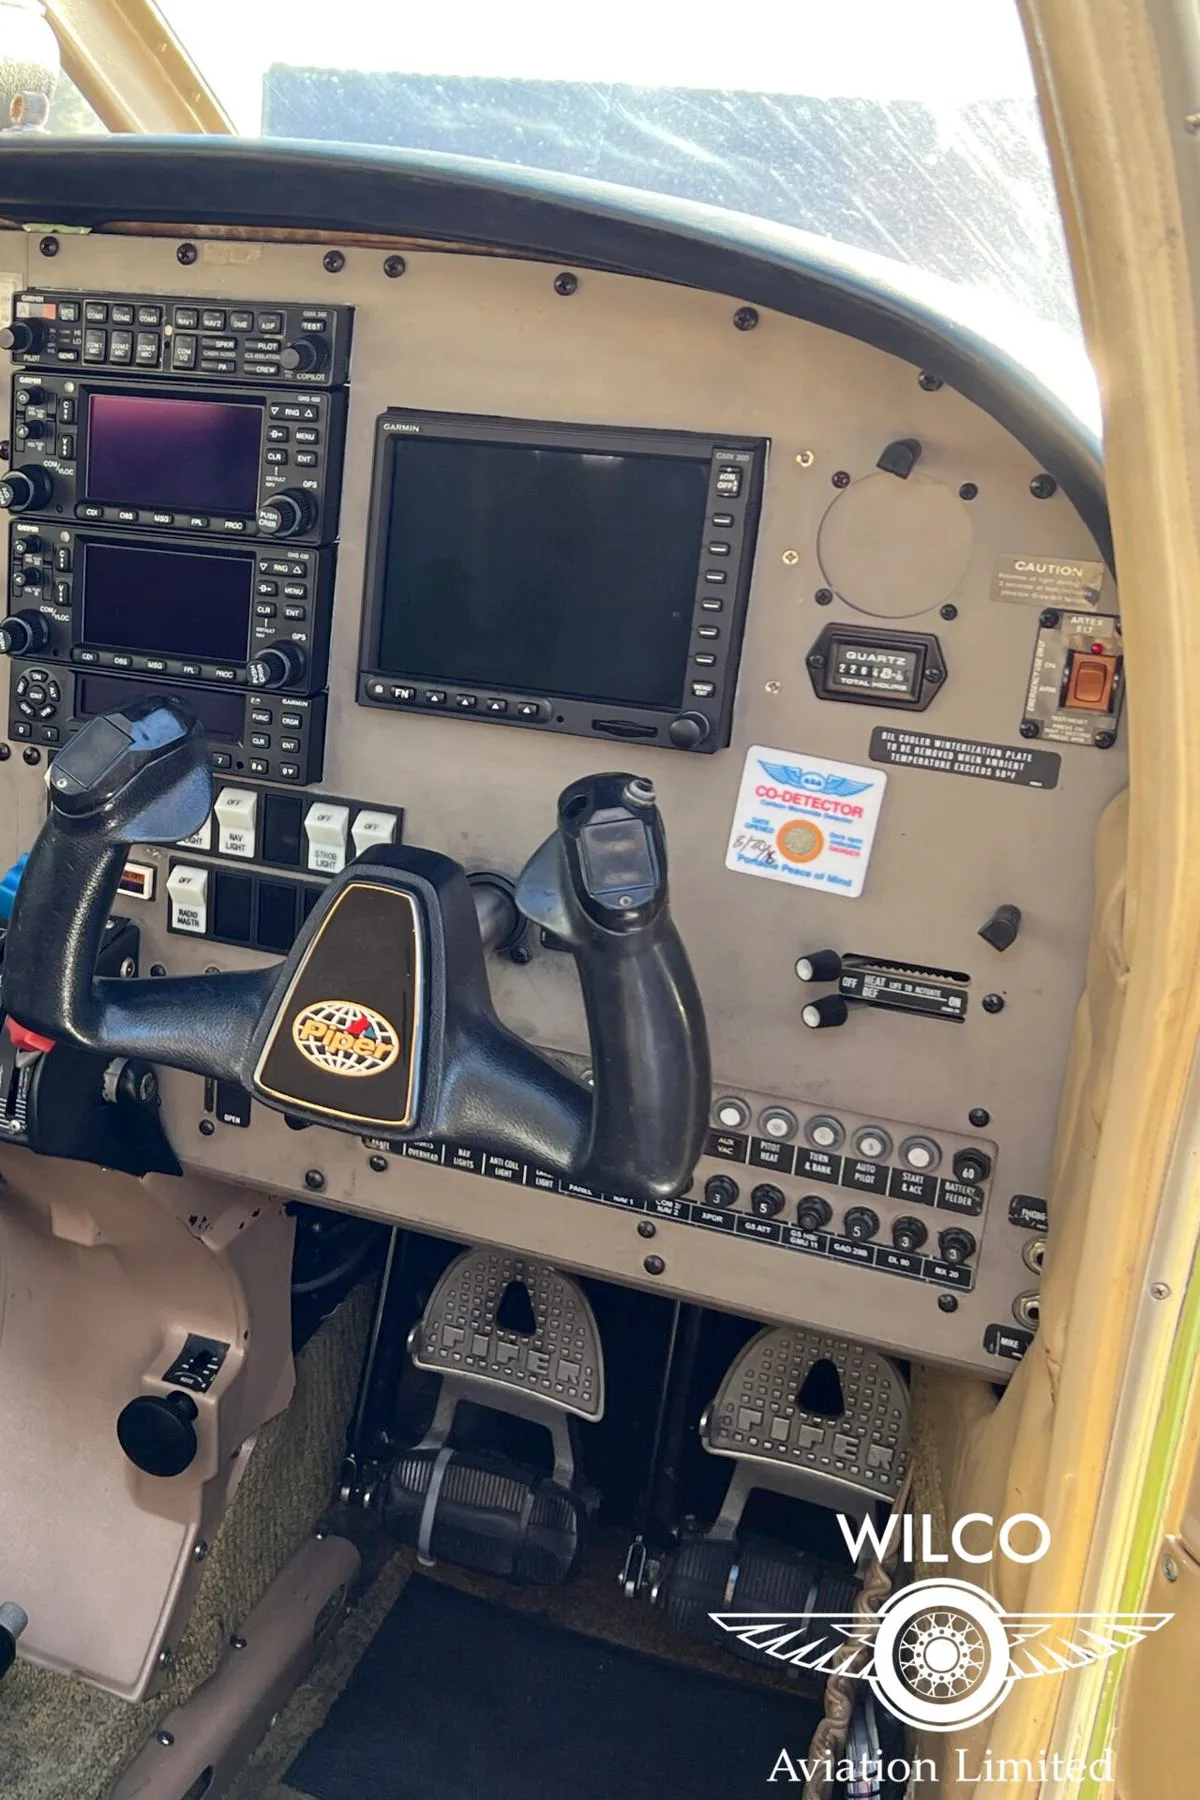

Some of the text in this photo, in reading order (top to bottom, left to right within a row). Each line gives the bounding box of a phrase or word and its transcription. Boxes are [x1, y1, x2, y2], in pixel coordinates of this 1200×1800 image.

[303, 322, 321, 330] TEST
[258, 342, 277, 350] PILOT
[256, 366, 275, 374] CREW
[296, 373, 325, 381] COPILOT
[285, 408, 299, 416] RNG
[383, 423, 420, 433] GARMIN
[296, 432, 315, 440] MENU
[302, 480, 318, 488] GPS
[717, 481, 732, 489] OFF
[86, 508, 98, 516] CDI
[119, 512, 133, 520] OBS
[260, 511, 278, 520] PUSH
[153, 514, 169, 523] MSG
[191, 518, 203, 526] FPL
[259, 519, 277, 528] CRSR
[224, 521, 243, 529] PROC
[273, 563, 289, 572] RNG
[1014, 560, 1084, 577] CAUTION
[285, 587, 303, 595] MENU
[257, 606, 271, 614] CLR
[285, 608, 300, 617] ENT
[1070, 616, 1104, 628] ARTEX
[1076, 625, 1093, 633] ELT
[291, 632, 307, 641] GPS
[81, 653, 94, 661] CDI
[114, 657, 128, 665] OBS
[845, 651, 907, 666] QUARTZ
[148, 661, 163, 670] MSG
[183, 666, 194, 674] FPL
[215, 670, 233, 678] PROC
[841, 677, 907, 691] TOTAL HOURS
[395, 688, 409, 699] FN
[282, 698, 308, 707] GARMIN
[252, 713, 269, 722] FUNC
[282, 717, 299, 726] CRSR
[252, 737, 265, 745] CLR
[881, 731, 1033, 762] OIL COOLER WINTERIZATION PLATE
[886, 742, 1025, 771] TO BE REMOVED WHEN AMBIENT
[890, 753, 951, 770] TEMPERATURE
[954, 763, 993, 776] EXCEEDS
[226, 798, 242, 807] OFF
[755, 785, 864, 818] CO-DETECTOR
[316, 813, 332, 822] OFF
[751, 816, 770, 825] DATE
[364, 822, 378, 831] OFF
[743, 822, 775, 834] OPENED
[229, 833, 243, 843] NAV
[225, 841, 246, 852] LIGHT
[315, 849, 337, 860] STROB
[315, 858, 337, 870] LIGHT
[781, 863, 812, 878] Peace
[814, 872, 825, 882] of
[827, 875, 853, 887] Mind
[178, 876, 192, 885] OFF
[178, 908, 198, 919] RADIO
[177, 917, 200, 927] MASTR
[842, 974, 942, 997] OFF HEAT LIFT TO ACTUATE
[862, 987, 879, 998] DEF
[948, 996, 961, 1008] ON
[299, 1018, 395, 1060] Piper
[224, 1114, 241, 1124] OPEN
[717, 1135, 734, 1146] AUX
[717, 1144, 734, 1155] VAC
[760, 1140, 781, 1152] PITOT
[408, 1147, 439, 1162] OVERHEAD
[458, 1148, 471, 1158] NAV
[760, 1150, 779, 1162] HEAT
[809, 1151, 829, 1163] TURN
[453, 1156, 474, 1169] LIGHTS
[489, 1156, 519, 1170] ANTI COLL
[855, 1162, 876, 1173] AUTO
[494, 1167, 513, 1178] LIGHT
[812, 1163, 832, 1176] BANK
[962, 1167, 975, 1179] 60
[535, 1176, 554, 1188] LIGHT
[855, 1173, 875, 1185] PILOT
[902, 1171, 924, 1184] START
[908, 1184, 923, 1195] ACC
[945, 1182, 976, 1195] BATTERY
[944, 1192, 973, 1207] FEEDER
[1001, 1336, 1019, 1349] MIKE
